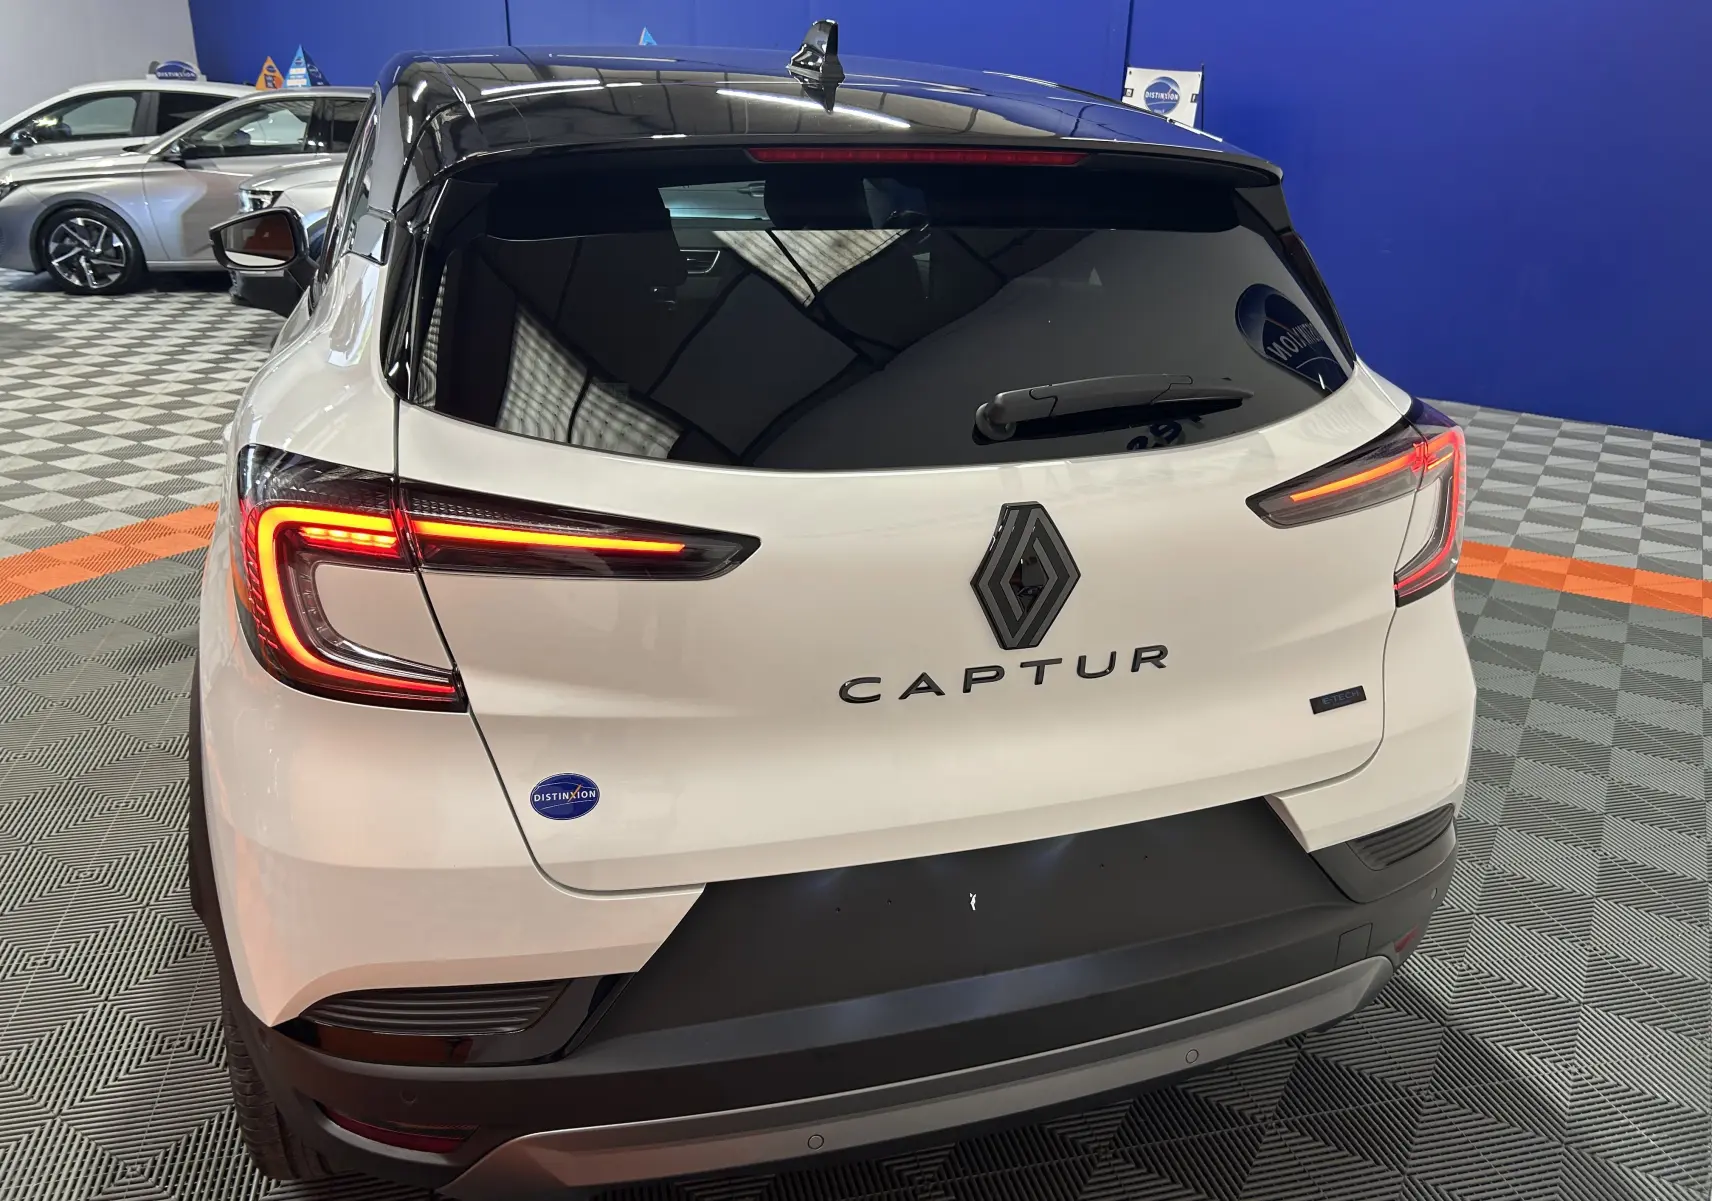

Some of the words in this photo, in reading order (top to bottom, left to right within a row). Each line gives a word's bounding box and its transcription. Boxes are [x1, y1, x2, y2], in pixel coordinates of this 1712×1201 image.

[1145, 91, 1179, 101] DISTINXION
[839, 645, 1169, 704] CAPTUR
[1322, 690, 1360, 705] E-TECH
[534, 788, 596, 802] DISTINXION
